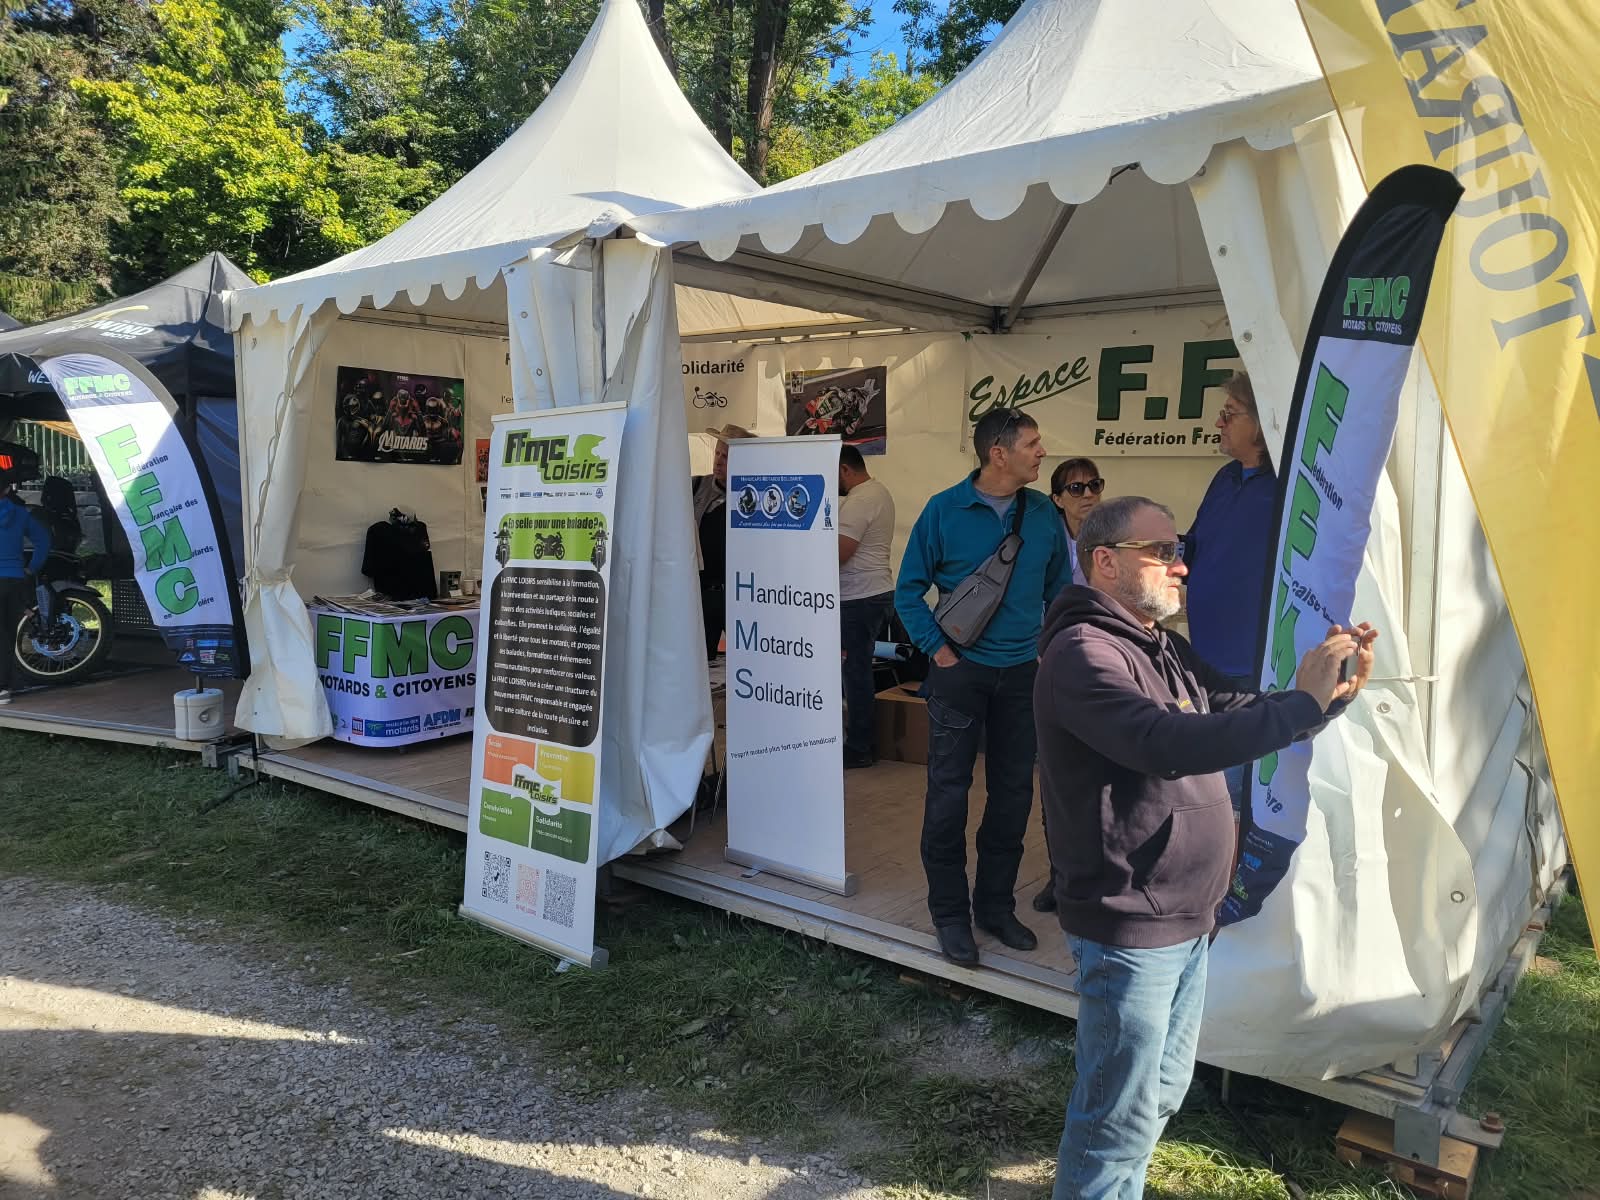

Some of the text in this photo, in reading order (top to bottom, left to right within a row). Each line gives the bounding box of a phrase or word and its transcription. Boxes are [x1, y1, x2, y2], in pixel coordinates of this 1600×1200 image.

[1343, 276, 1411, 320] FFMC
[681, 359, 746, 375] olidarité
[27, 370, 51, 384] WE
[63, 374, 131, 396] FFMC
[1097, 339, 1240, 421] F.F
[969, 357, 1090, 422] Espace
[1094, 427, 1222, 446] Fédération Fra
[184, 498, 199, 508] des
[515, 518, 532, 529] selle
[534, 520, 550, 530] pour
[552, 519, 566, 529] une
[578, 596, 594, 604] route
[735, 571, 835, 613] Handicaps
[316, 613, 474, 679] FFMC
[530, 636, 540, 644] tous
[577, 642, 600, 652] propose
[735, 619, 814, 659] Motards
[526, 650, 552, 660] formations
[374, 684, 387, 699] &
[392, 672, 477, 697] CITOYENS
[527, 680, 537, 688] vise
[541, 682, 554, 690] créer
[734, 668, 824, 711] Solidarité
[534, 697, 562, 707] responsable
[423, 708, 462, 728] AFDM
[532, 710, 538, 718] de
[544, 713, 558, 722] route
[385, 723, 420, 736] motards
[769, 746, 780, 755] plus
[792, 743, 802, 751] que
[802, 740, 808, 748] le
